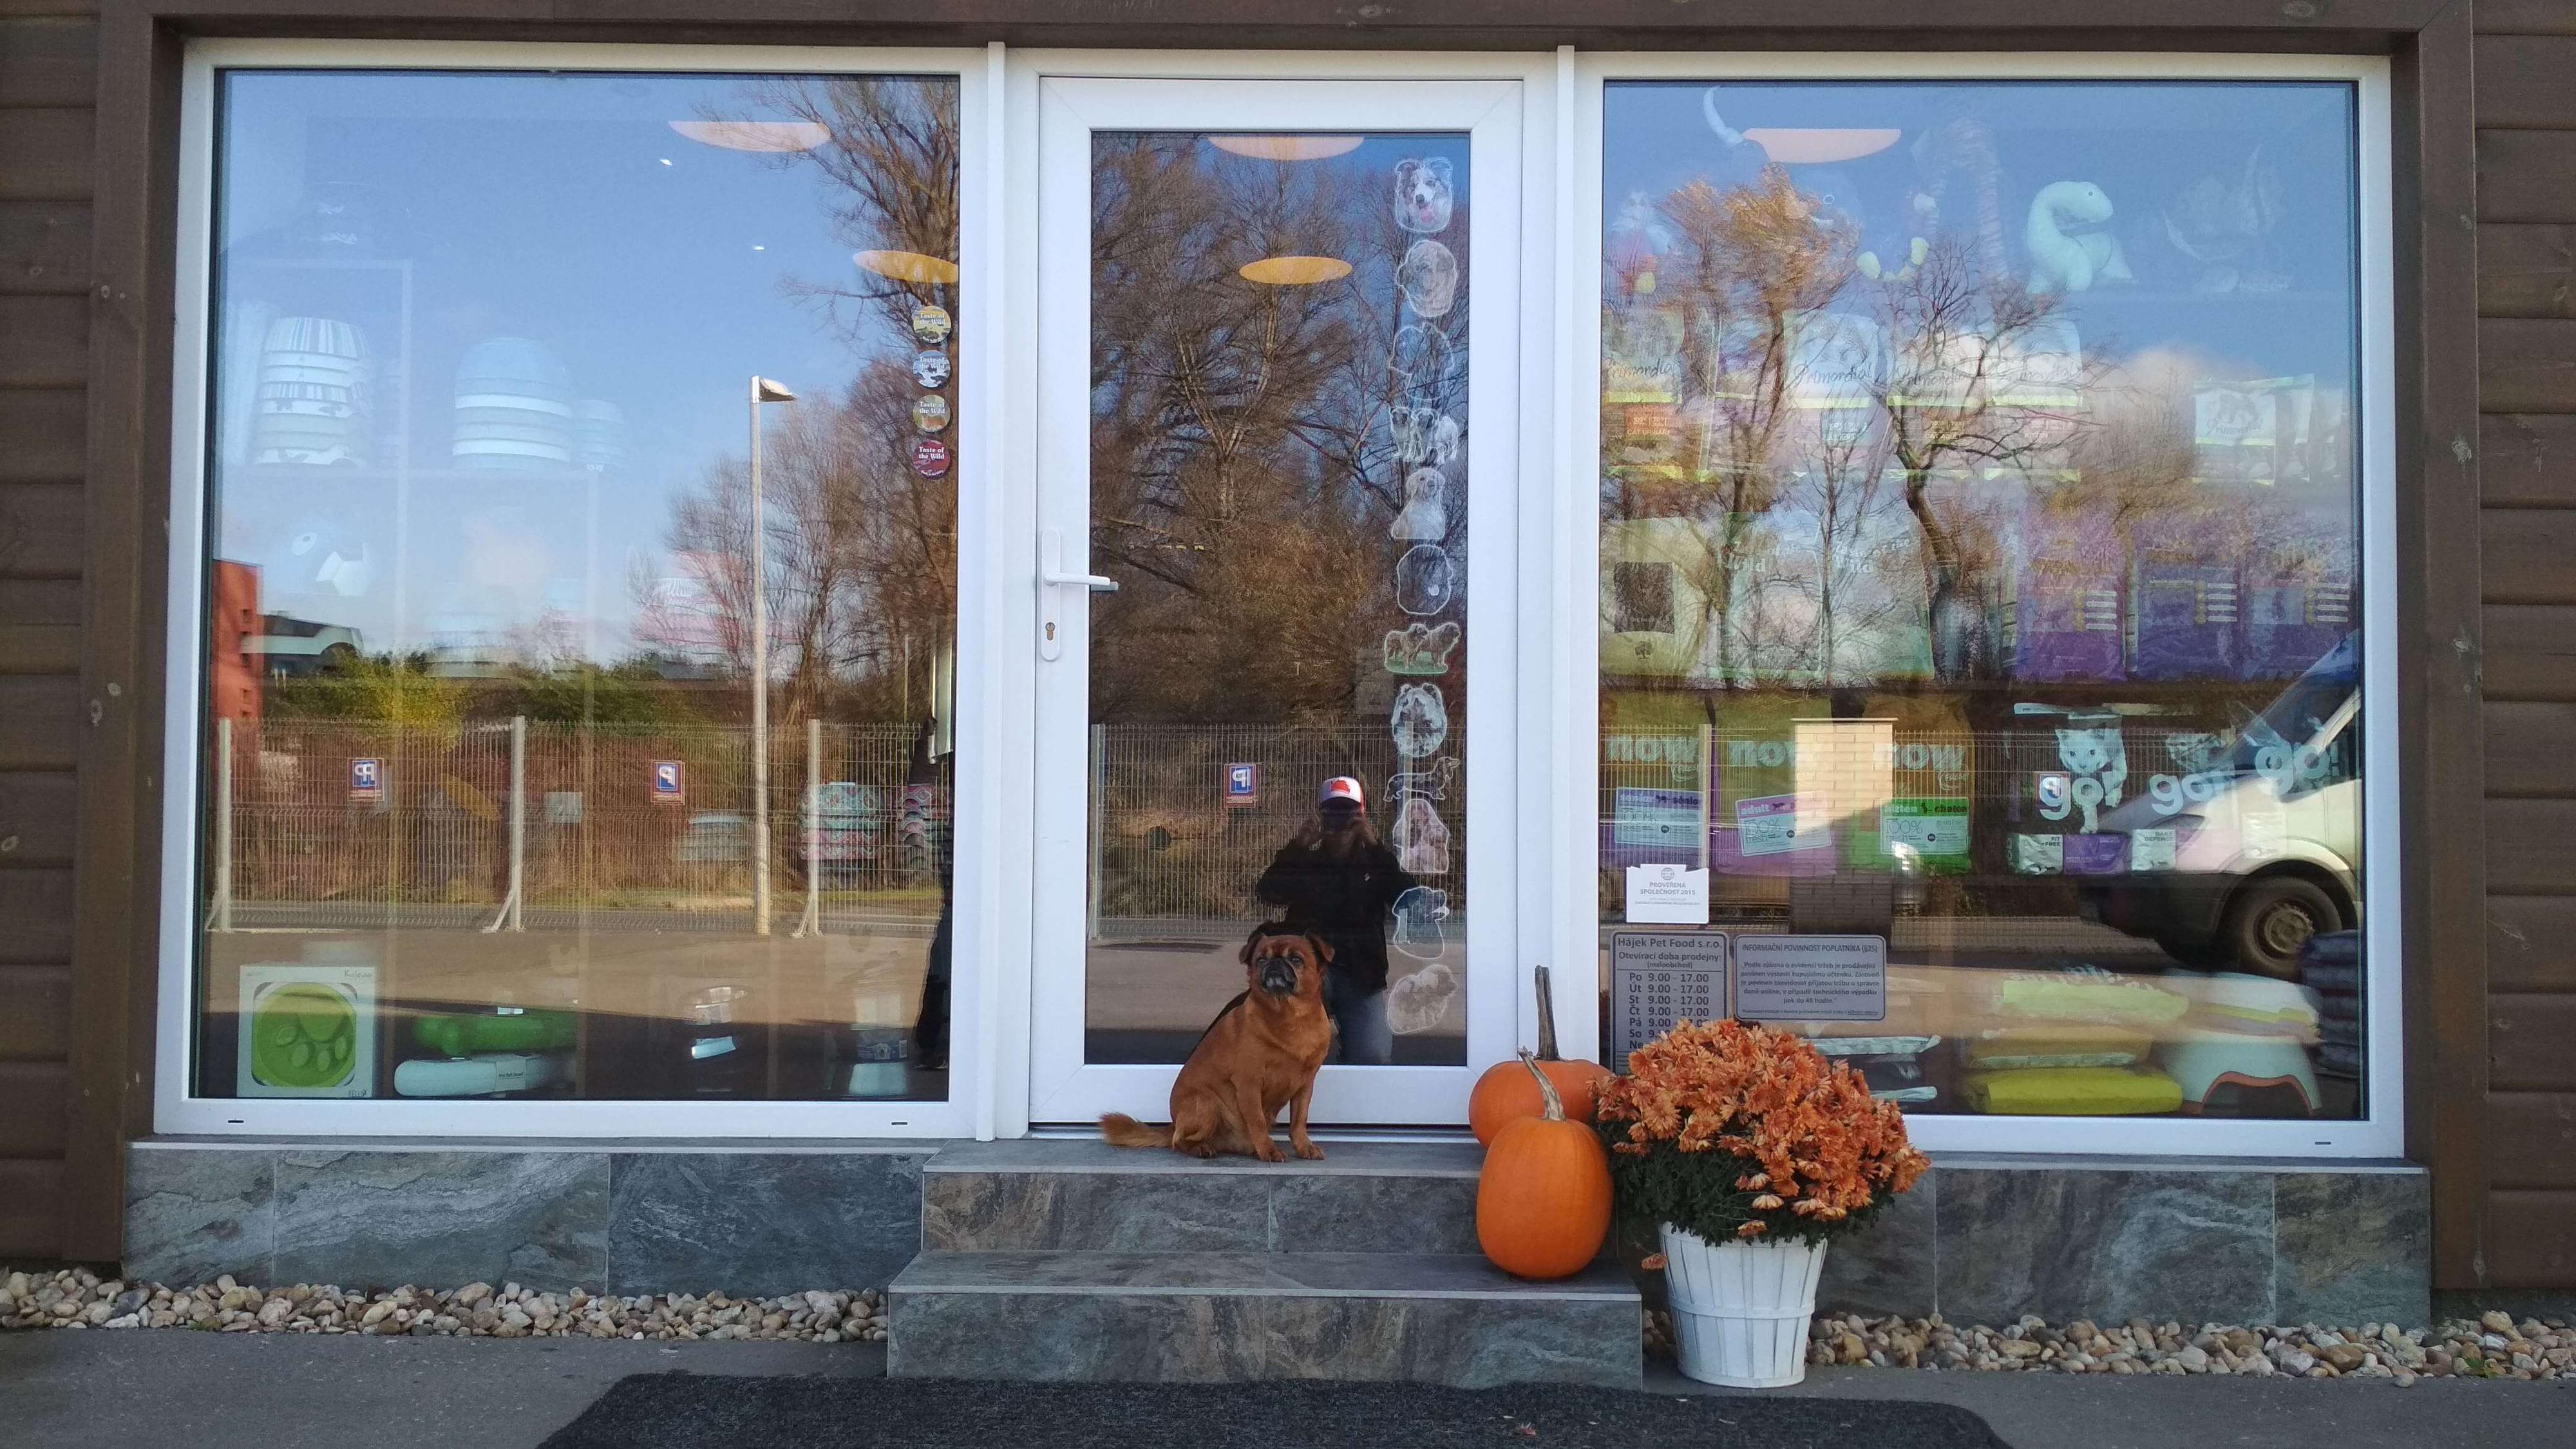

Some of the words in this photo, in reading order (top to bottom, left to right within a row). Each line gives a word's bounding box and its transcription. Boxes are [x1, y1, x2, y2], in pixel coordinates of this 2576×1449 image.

[1608, 735, 1699, 763] now
[1740, 804, 1770, 815] adult
[1886, 818, 1923, 835] 100%
[1618, 937, 1647, 948] Hájek
[1650, 938, 1667, 948] Pet
[1670, 938, 1695, 948] Food
[1742, 942, 1783, 952] INFORMAČNÍ
[1784, 943, 1821, 952] POVINNOST
[1822, 943, 1860, 952] POPLATNÍKA
[1618, 952, 1656, 960] Otevírací
[1629, 972, 1642, 981] Po
[1648, 973, 1671, 981] 9.00
[1680, 974, 1709, 983] 17.00
[1629, 981, 1642, 992] Út
[1648, 984, 1671, 992] 9.00
[1680, 985, 1709, 994] 17.00
[1629, 995, 1639, 1004] St
[1648, 996, 1671, 1005] 9.00
[1680, 996, 1709, 1005] 17.00
[1629, 1005, 1640, 1016] Čt
[1648, 1007, 1671, 1016] 9.00
[1680, 1007, 1709, 1016] 17.00
[1629, 1018, 1642, 1027] Pá
[1648, 1018, 1671, 1027] 9.00
[1629, 1029, 1642, 1038] So
[1629, 1041, 1643, 1049] Ne
